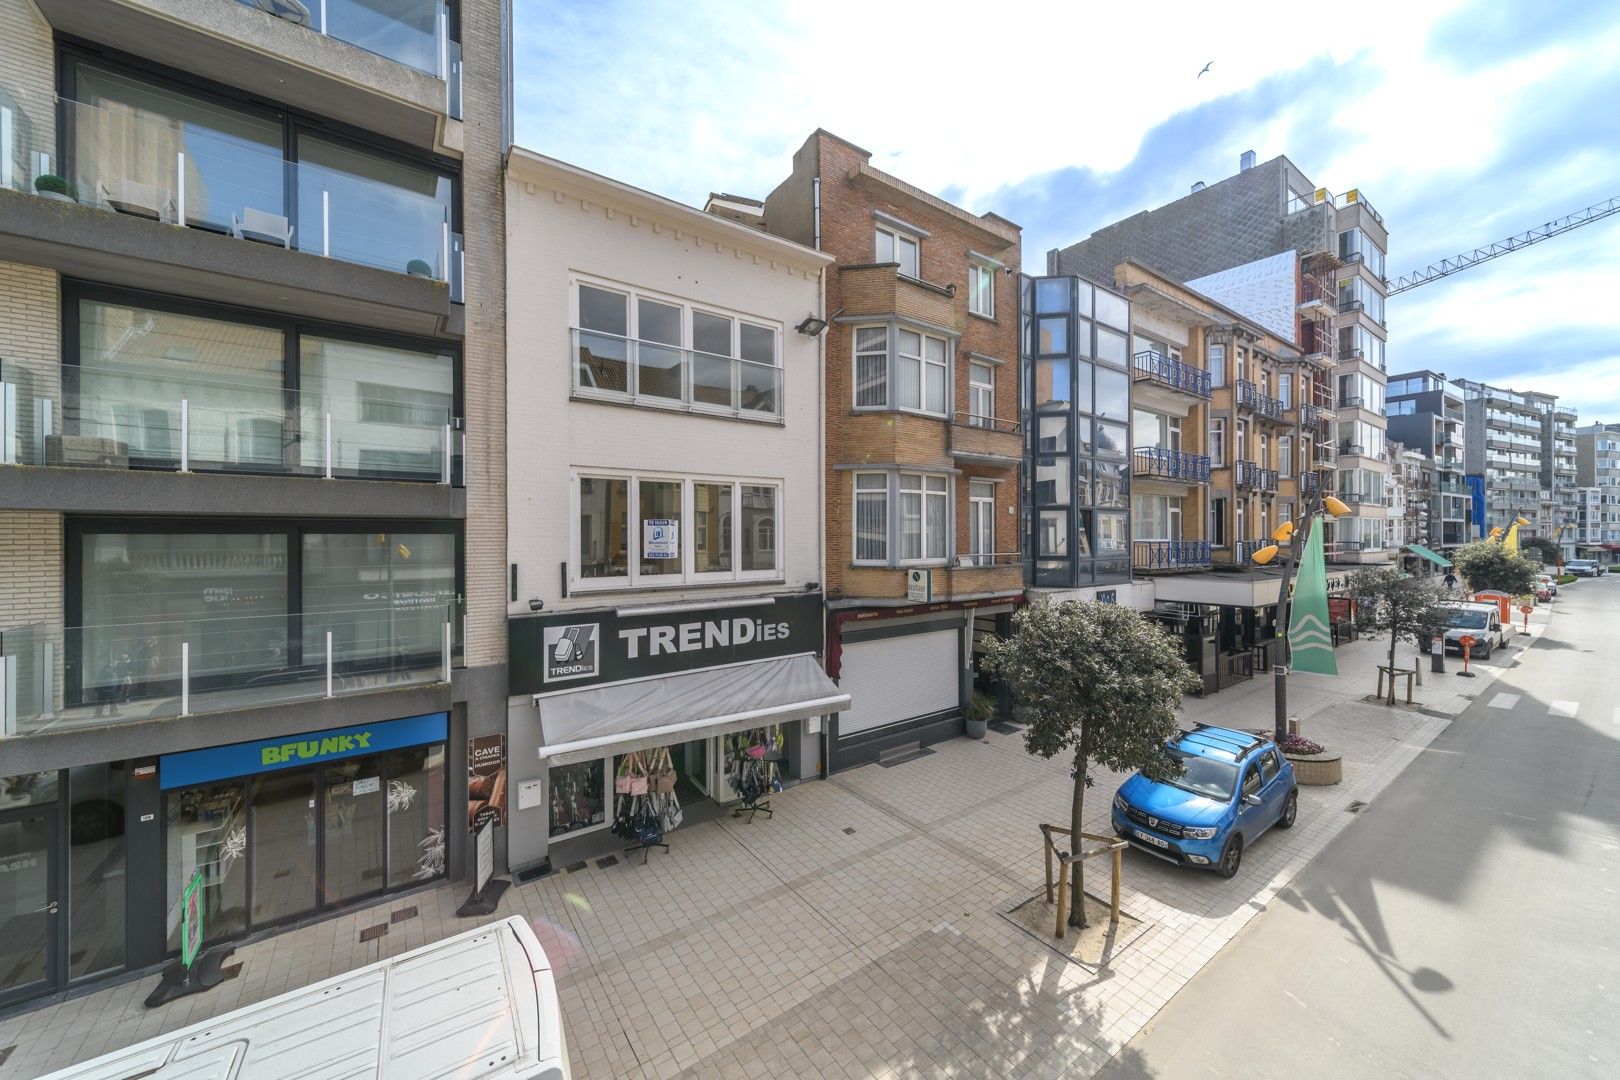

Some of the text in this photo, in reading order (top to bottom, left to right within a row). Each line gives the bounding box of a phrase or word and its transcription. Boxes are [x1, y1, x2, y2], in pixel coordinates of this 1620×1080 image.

[261, 731, 373, 766] BFUNKY
[475, 745, 500, 757] CAVE
[475, 759, 501, 768] HUMIDOR
